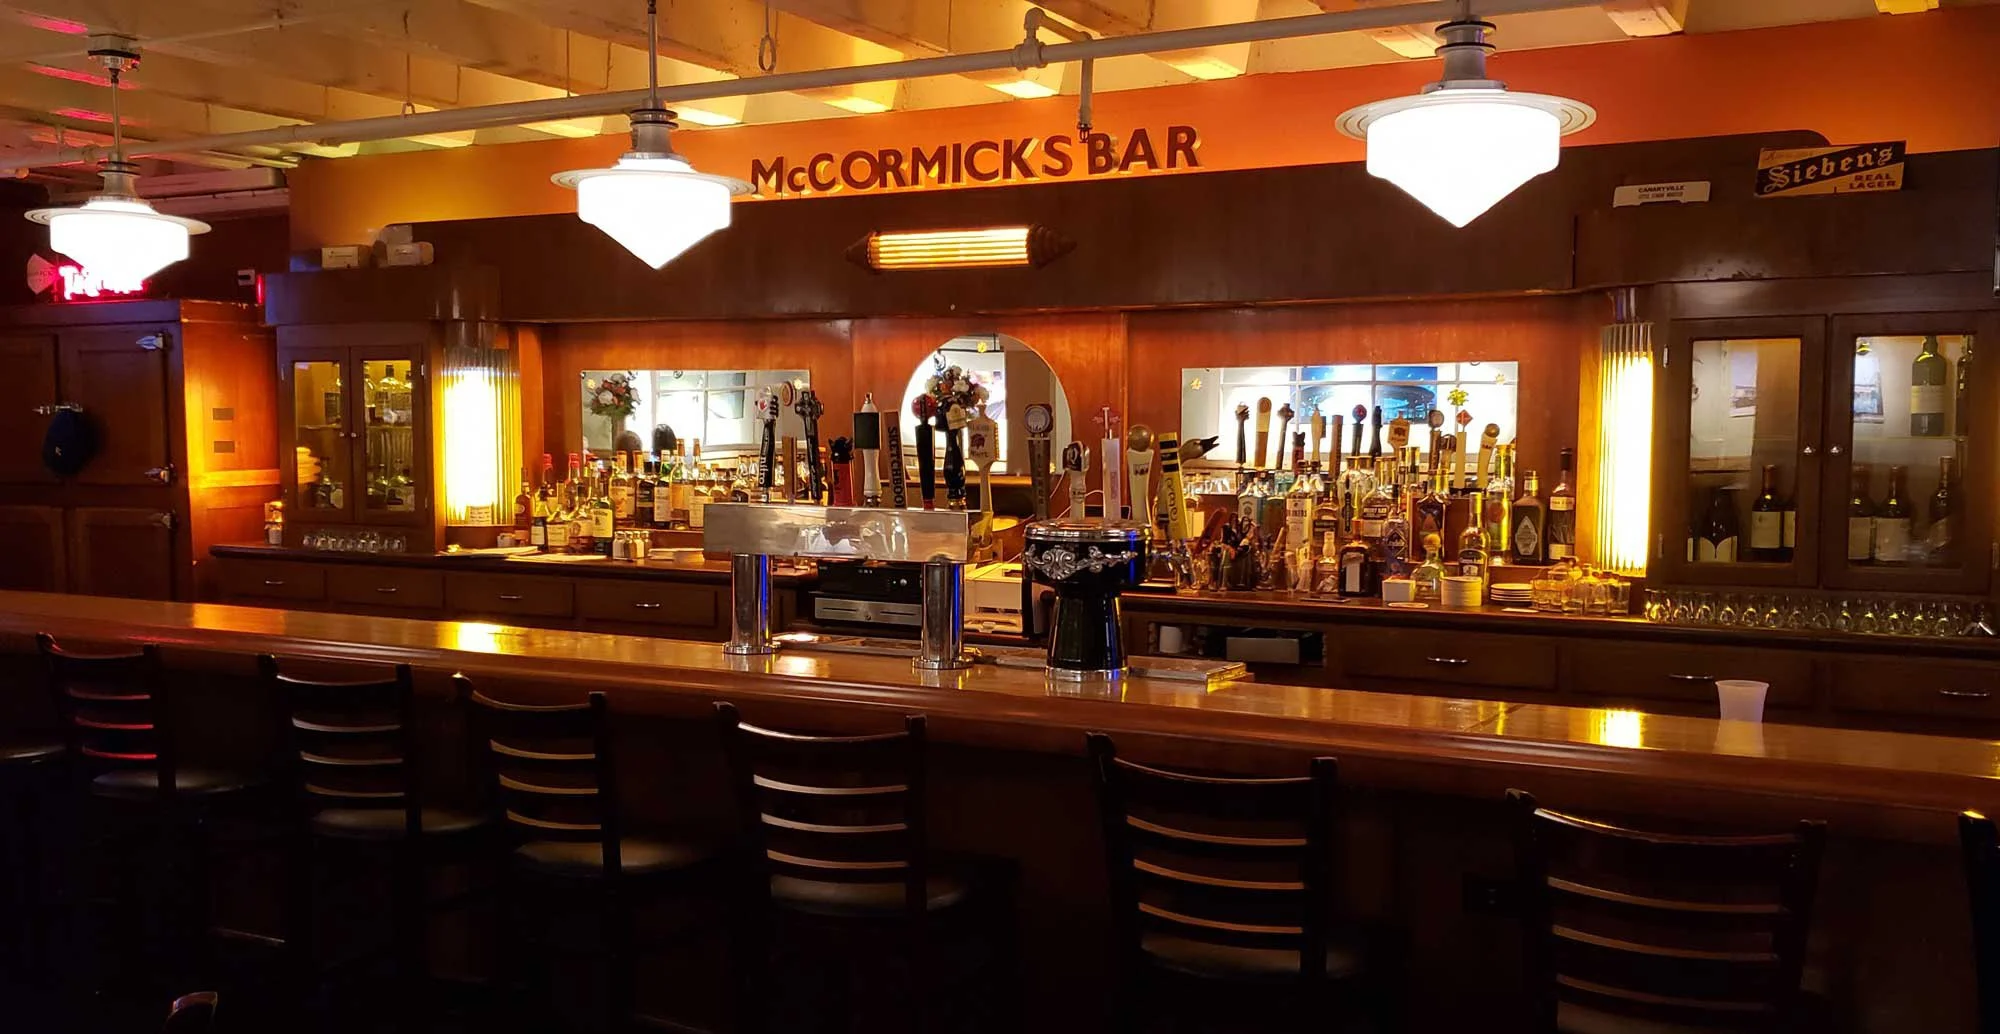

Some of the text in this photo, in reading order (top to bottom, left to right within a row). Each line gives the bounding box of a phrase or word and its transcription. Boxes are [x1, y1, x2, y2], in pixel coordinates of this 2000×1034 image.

[752, 126, 1200, 193] McCORMICKS BAR
[1764, 146, 1893, 193] Sieben's
[1849, 181, 1897, 190] LAGER
[1854, 173, 1893, 182] REAL
[759, 456, 768, 485] nitro
